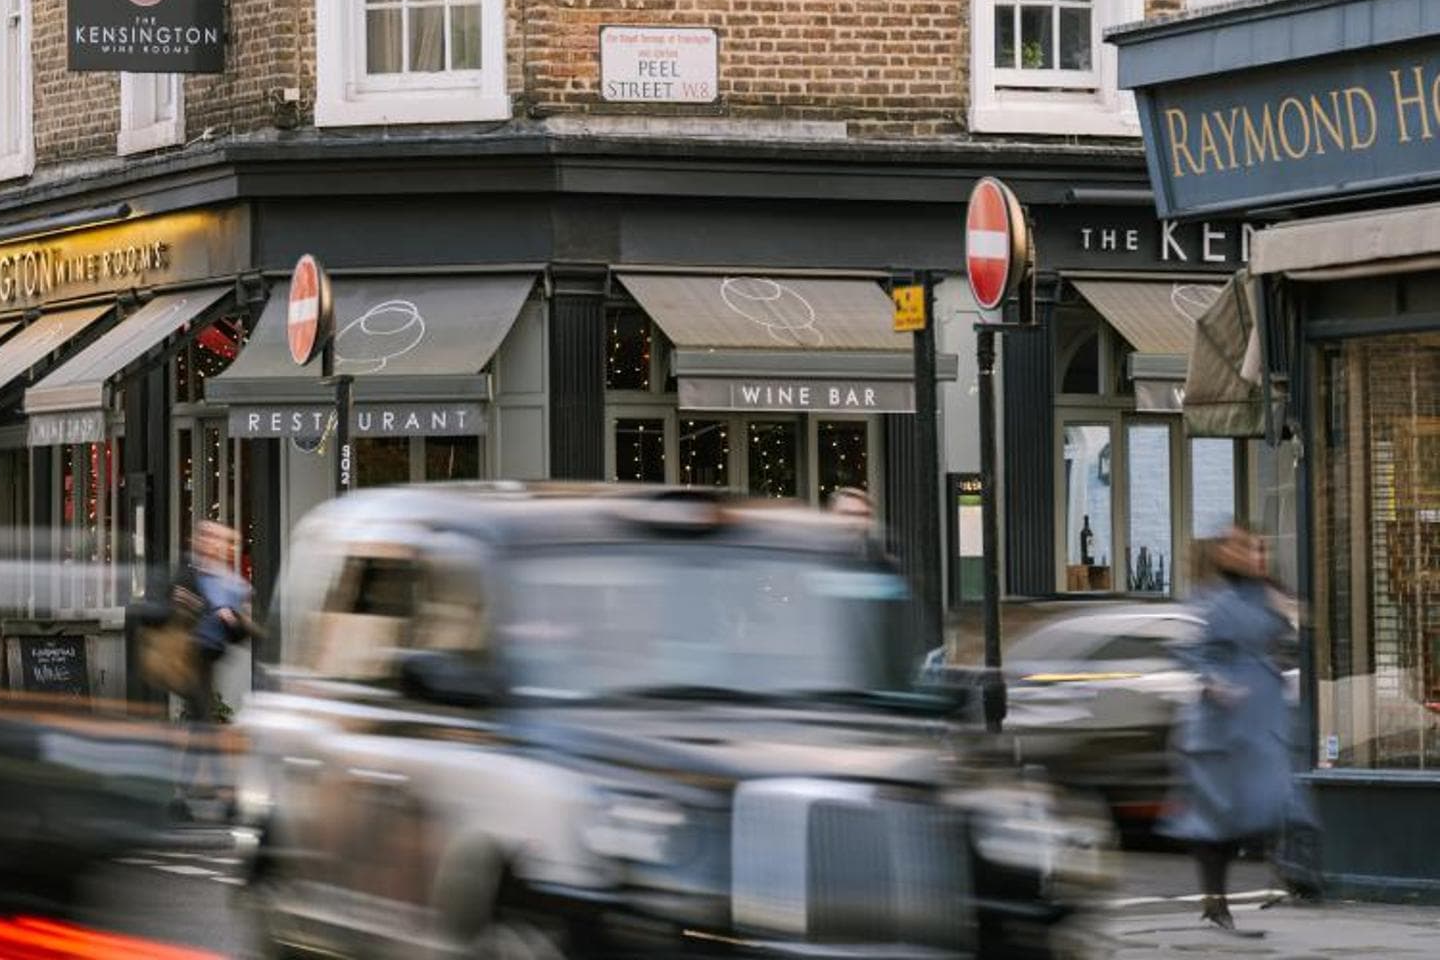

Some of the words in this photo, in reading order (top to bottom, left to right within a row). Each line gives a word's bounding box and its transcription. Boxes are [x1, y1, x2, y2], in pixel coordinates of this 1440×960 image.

[136, 16, 157, 25] THE
[75, 26, 217, 44] KENSINGTON
[101, 45, 134, 54] WINE
[143, 45, 189, 54] ROOMS
[639, 60, 680, 78] PEEL
[608, 81, 674, 98] STREET
[1166, 86, 1378, 178] RAYMOND
[1389, 65, 1440, 143] H
[1081, 228, 1139, 250] THE
[56, 254, 97, 286] WINE
[102, 240, 162, 279] ROOMS
[742, 387, 810, 406] WINE
[829, 388, 878, 407] BAR
